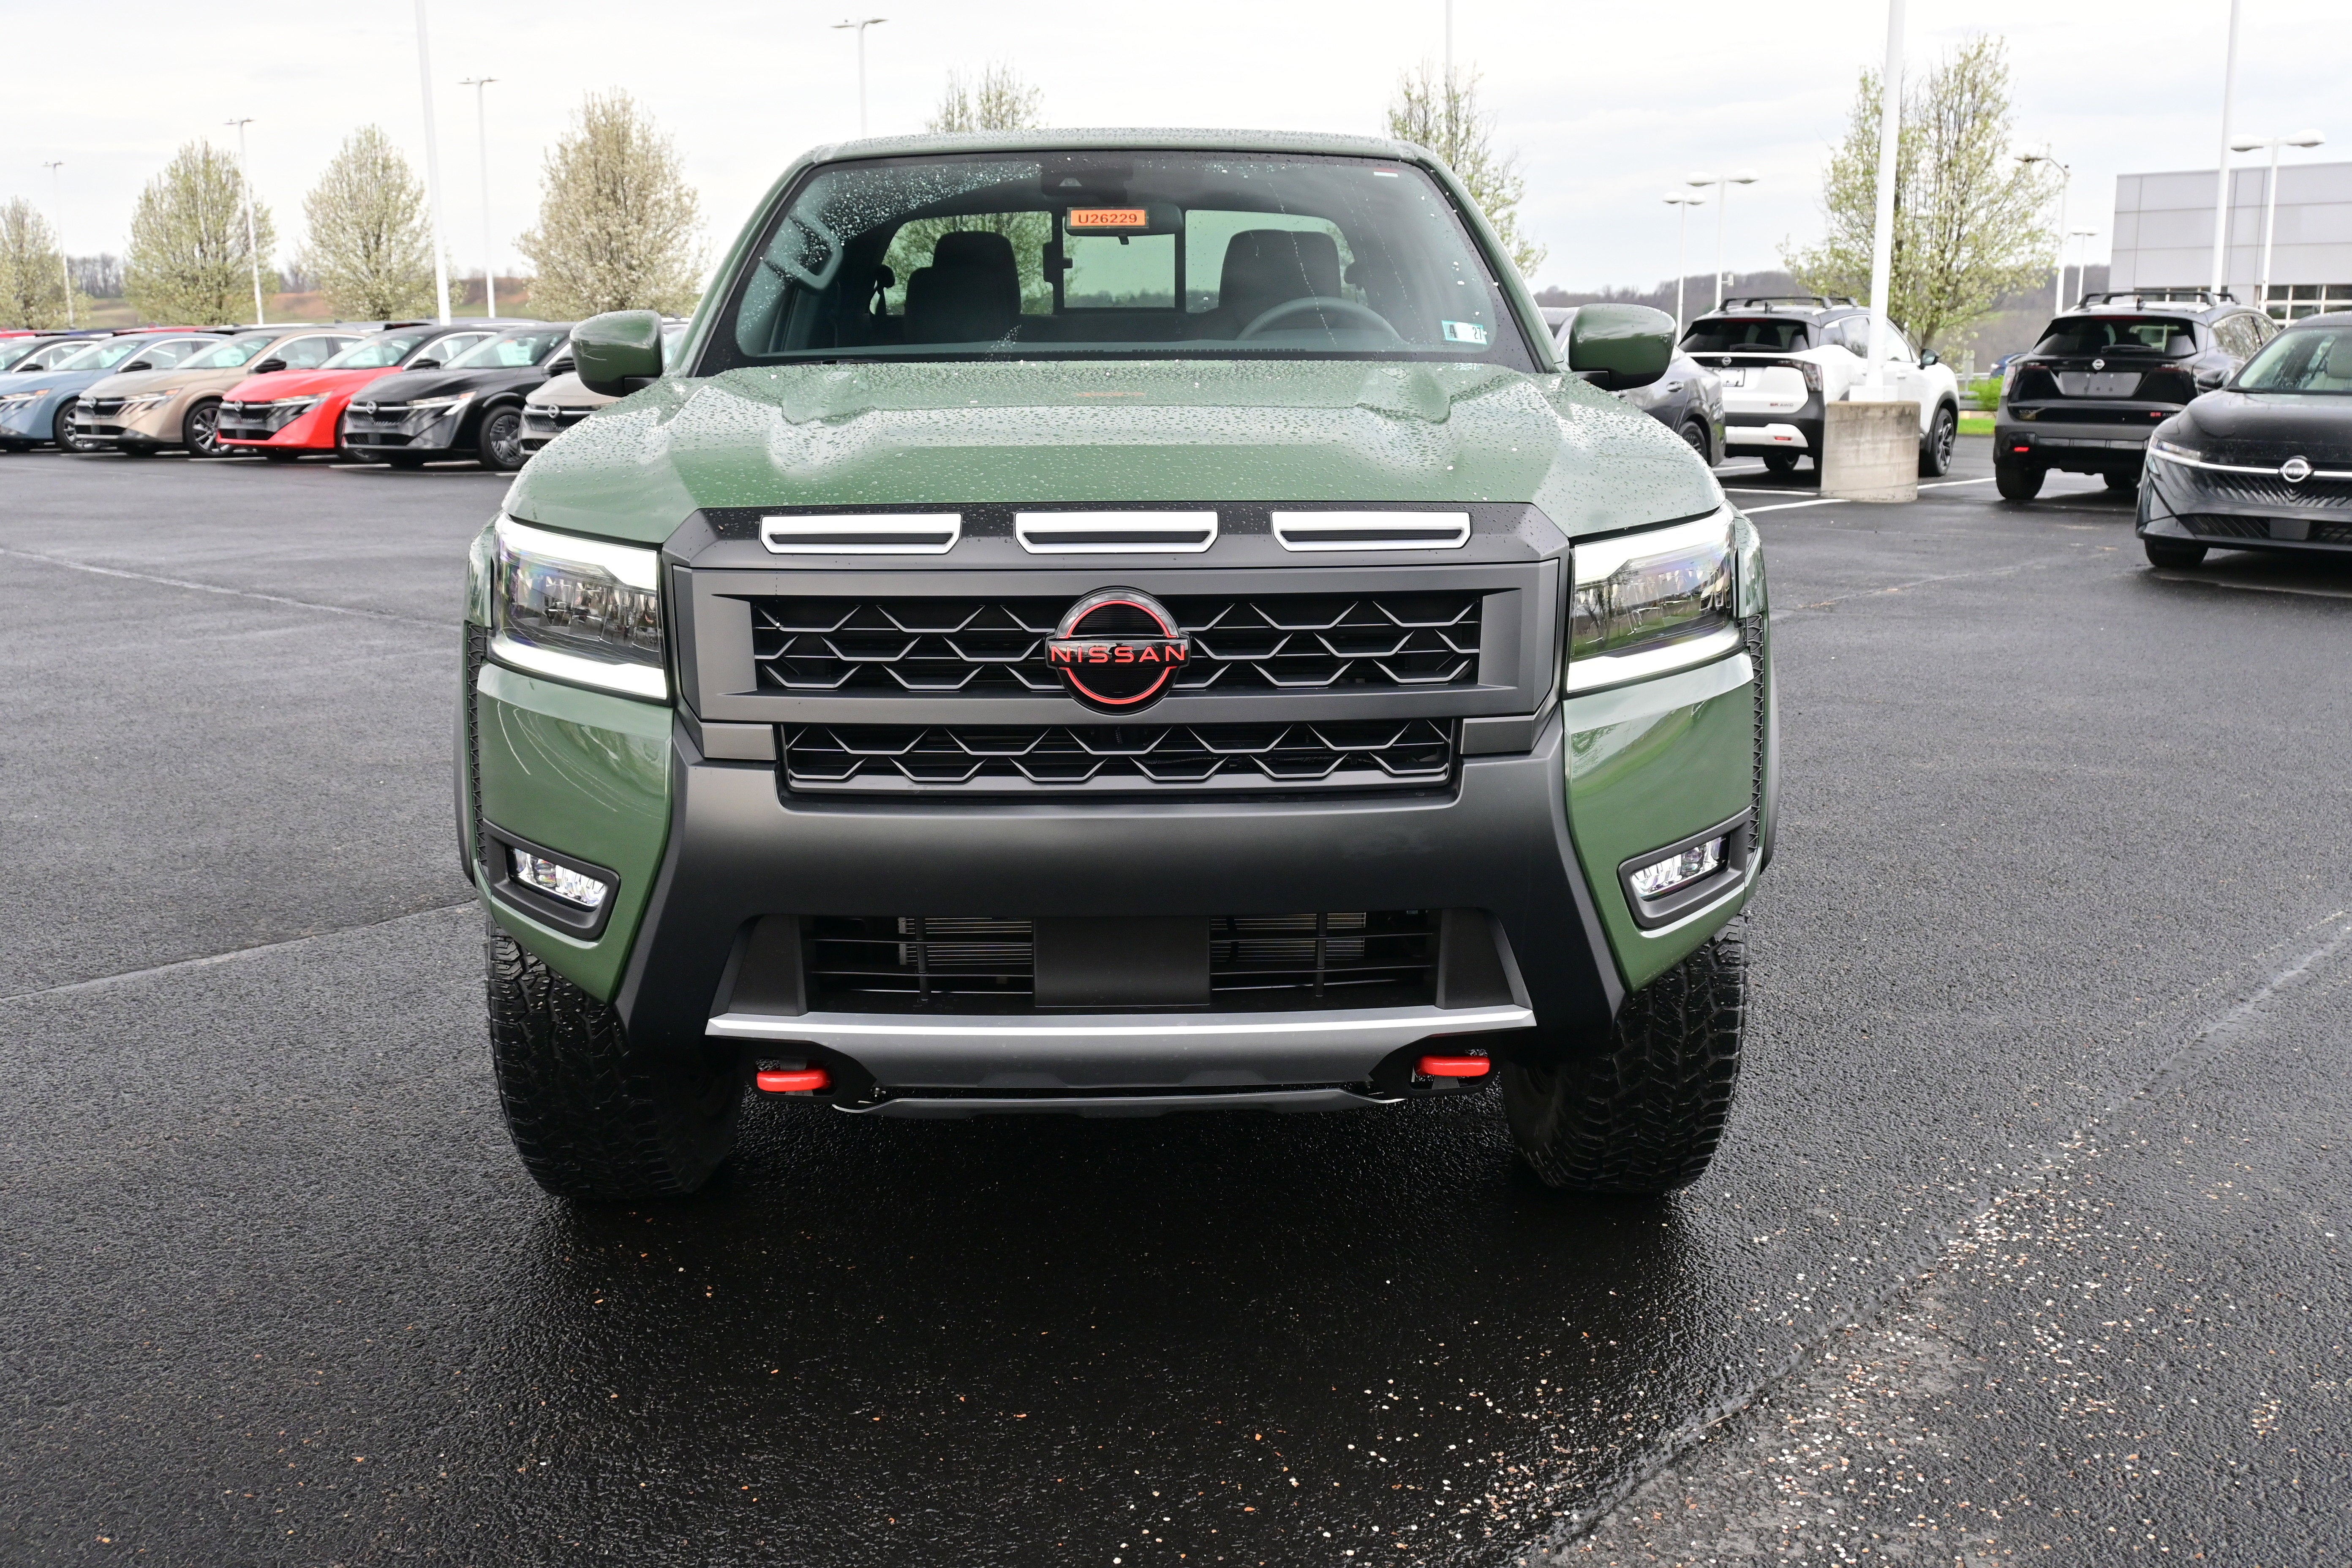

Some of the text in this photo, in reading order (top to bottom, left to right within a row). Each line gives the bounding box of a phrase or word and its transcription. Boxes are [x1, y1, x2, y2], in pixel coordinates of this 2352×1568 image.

[1078, 213, 1138, 224] U26229
[1449, 324, 1482, 340] 4 27
[1050, 644, 1185, 663] NISSAN
